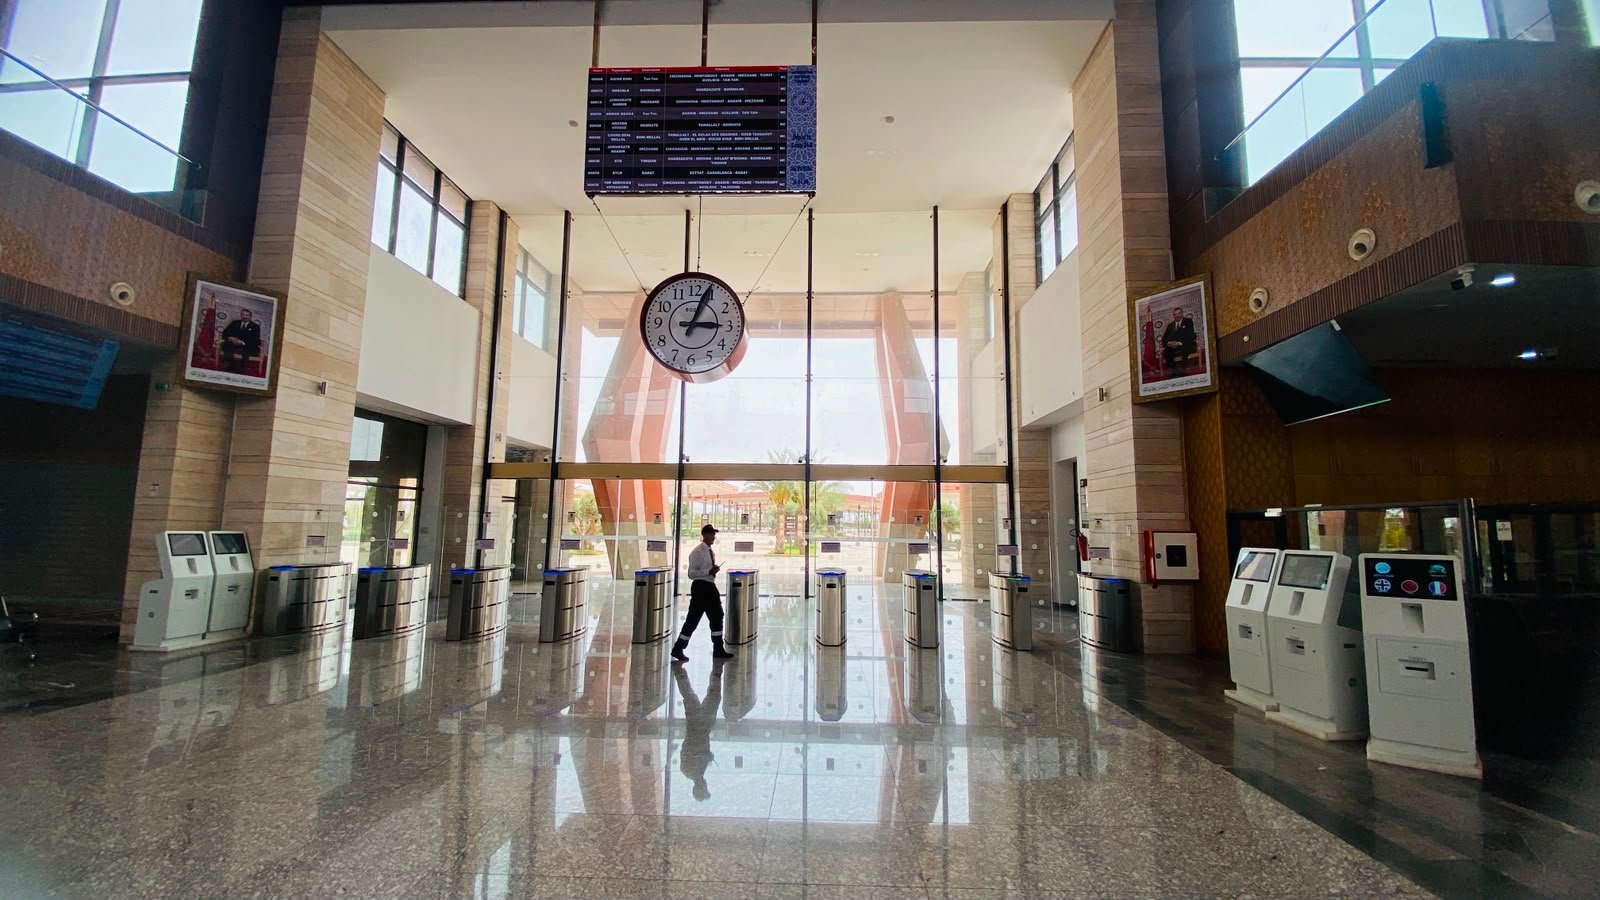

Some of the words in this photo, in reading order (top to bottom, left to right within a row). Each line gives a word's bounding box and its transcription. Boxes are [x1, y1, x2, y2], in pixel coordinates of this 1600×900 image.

[673, 289, 684, 300] 11
[688, 285, 702, 296] 12
[658, 301, 671, 312] 10
[722, 302, 729, 314] 2
[654, 317, 662, 329] 9
[725, 320, 733, 332] 3
[658, 335, 666, 347] 8
[717, 338, 726, 350] 4
[671, 349, 679, 361] 7
[687, 354, 695, 366] 6
[706, 351, 713, 361] 5
